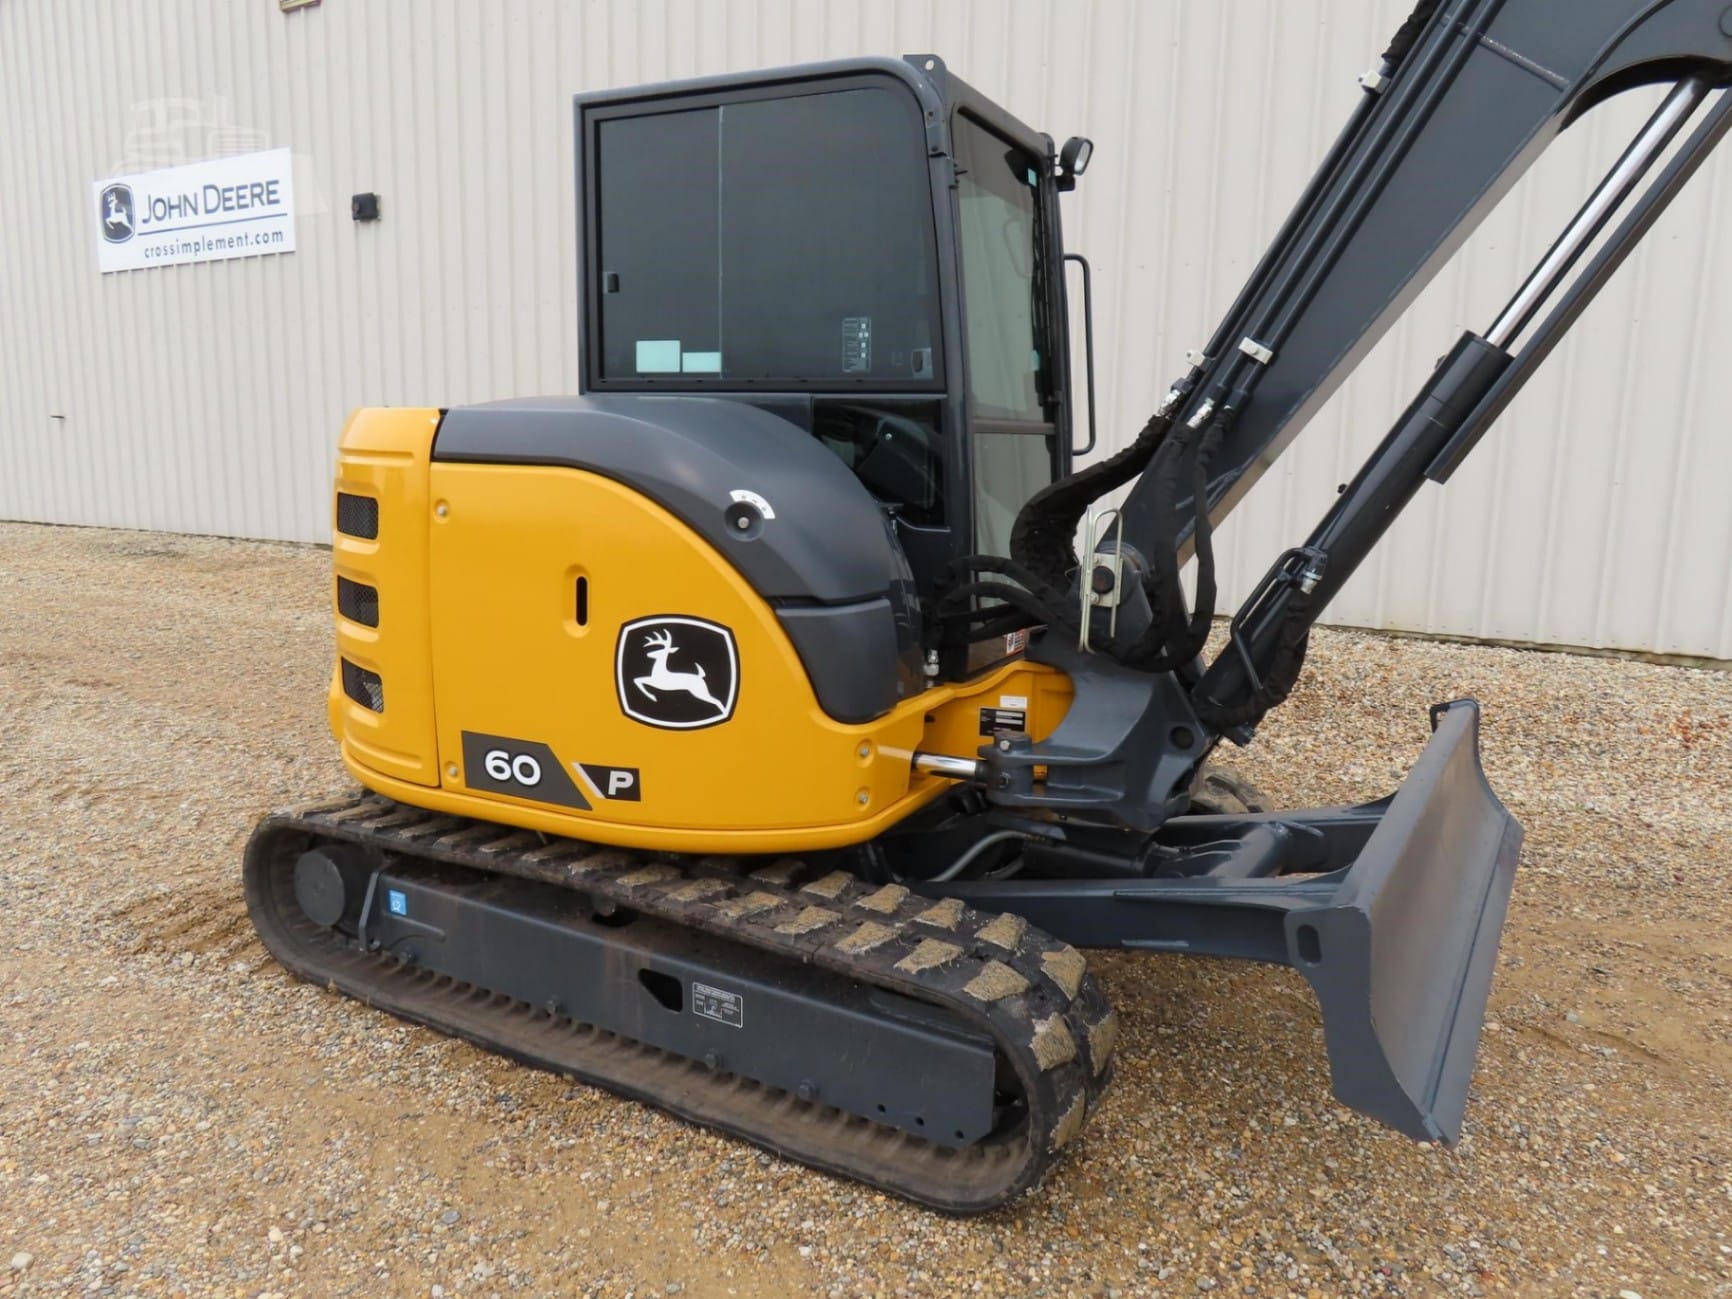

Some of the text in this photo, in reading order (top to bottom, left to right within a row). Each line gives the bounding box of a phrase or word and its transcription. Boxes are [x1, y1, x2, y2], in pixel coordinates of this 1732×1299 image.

[142, 180, 281, 224] JOHN DEERE
[144, 230, 284, 259] crossimplement.com
[485, 750, 634, 796] 60 P
